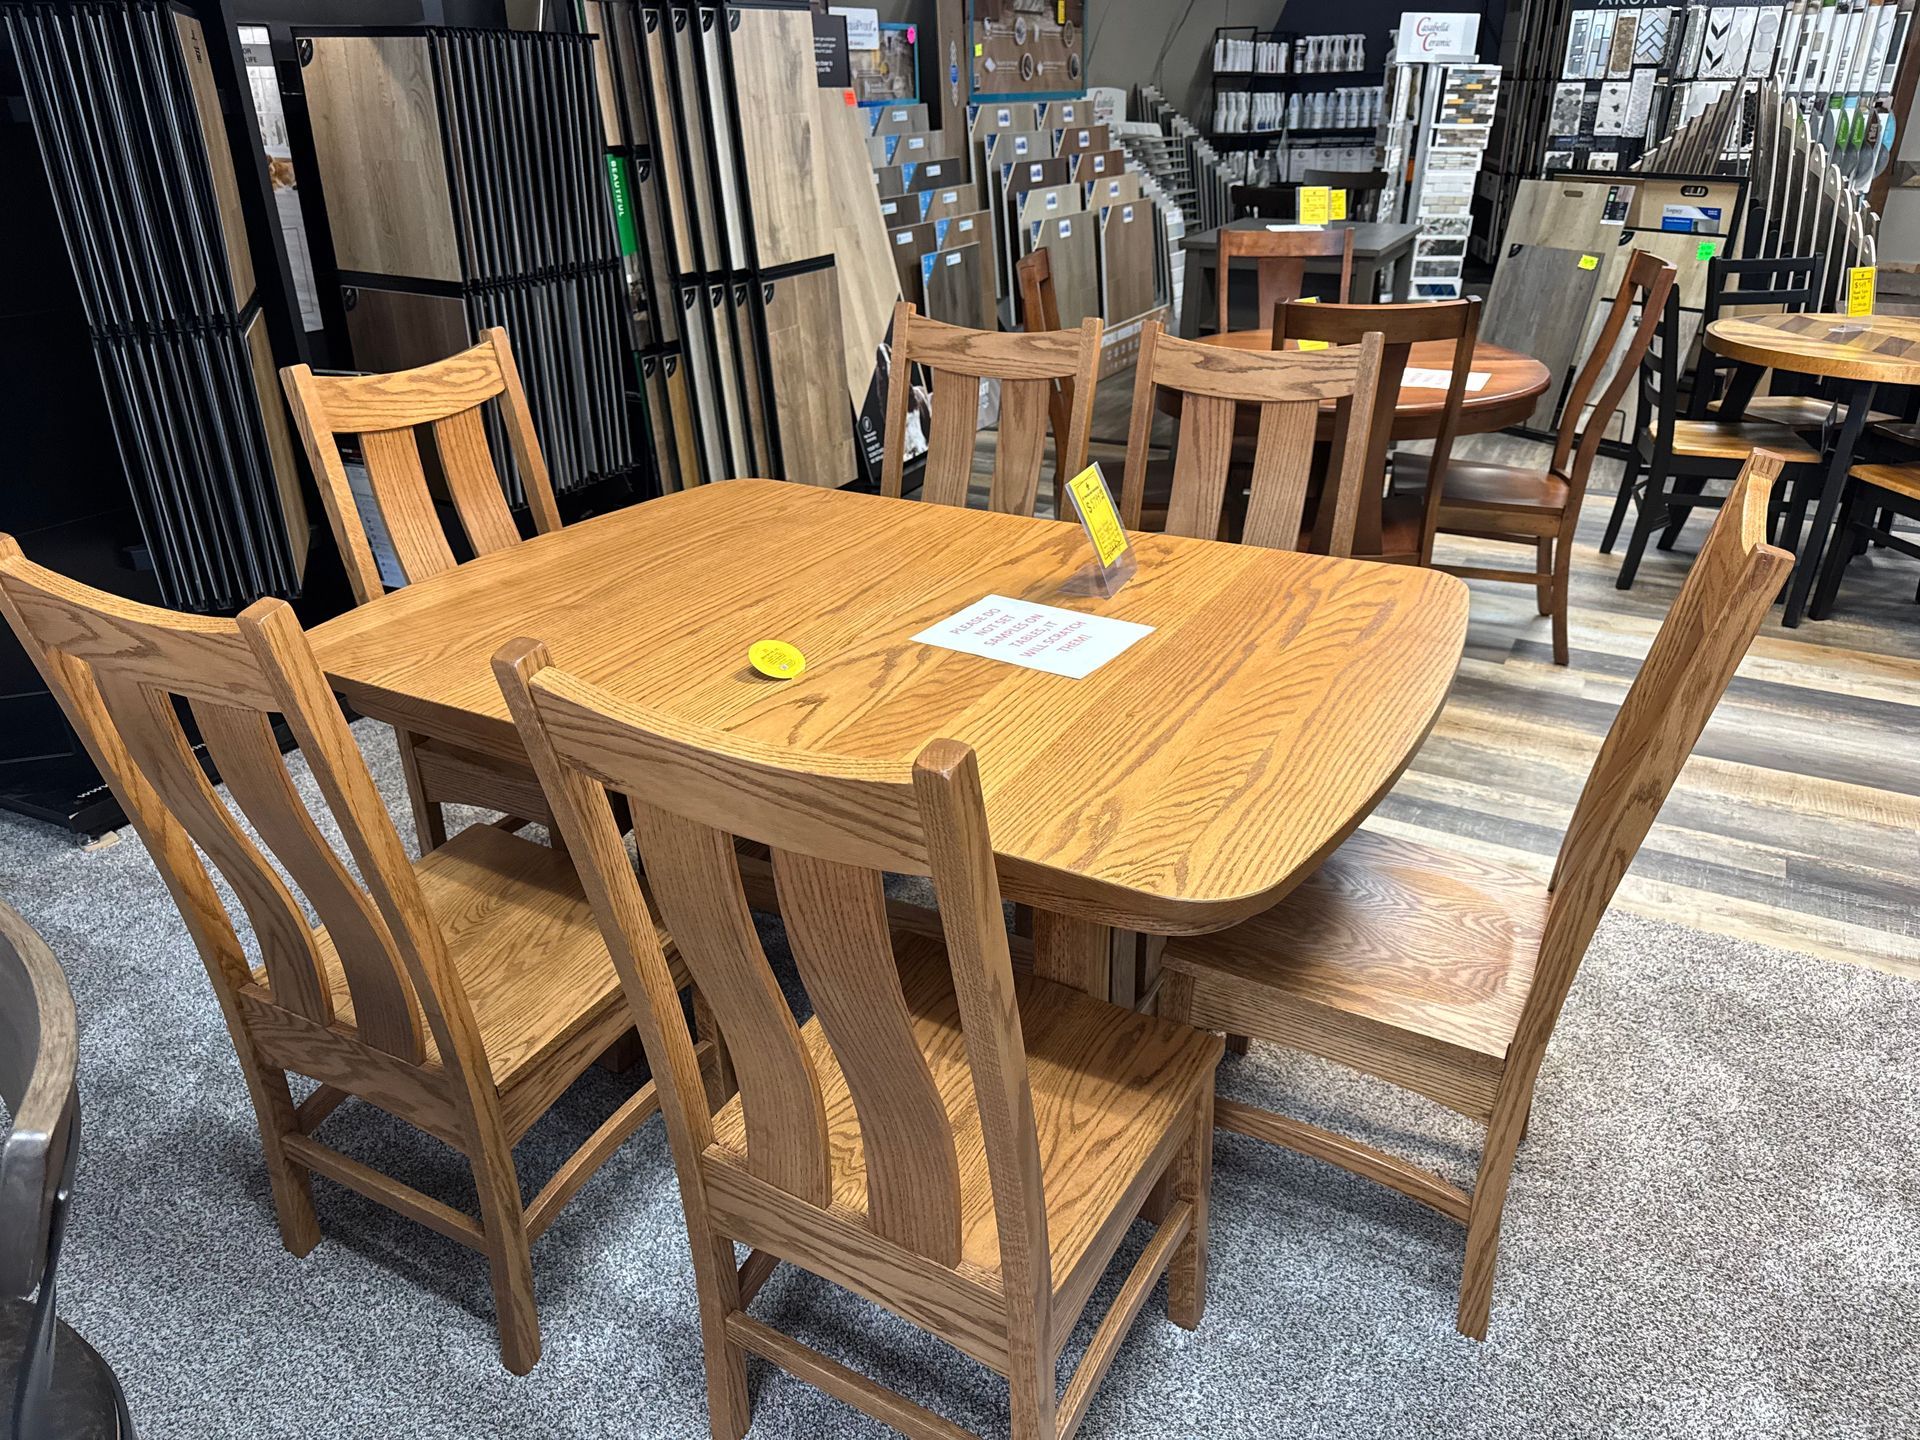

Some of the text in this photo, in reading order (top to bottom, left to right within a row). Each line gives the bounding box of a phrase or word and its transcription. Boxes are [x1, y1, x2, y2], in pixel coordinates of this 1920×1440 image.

[610, 160, 625, 217] BEAUTIFUL
[949, 608, 1001, 635] PLEASE DO
[974, 614, 1016, 636] NOT SET
[984, 613, 1044, 646] SAMPLES ON
[1044, 621, 1058, 629] IT
[1019, 620, 1087, 657] WILL SCRATCH
[1056, 634, 1092, 652] THEM!
